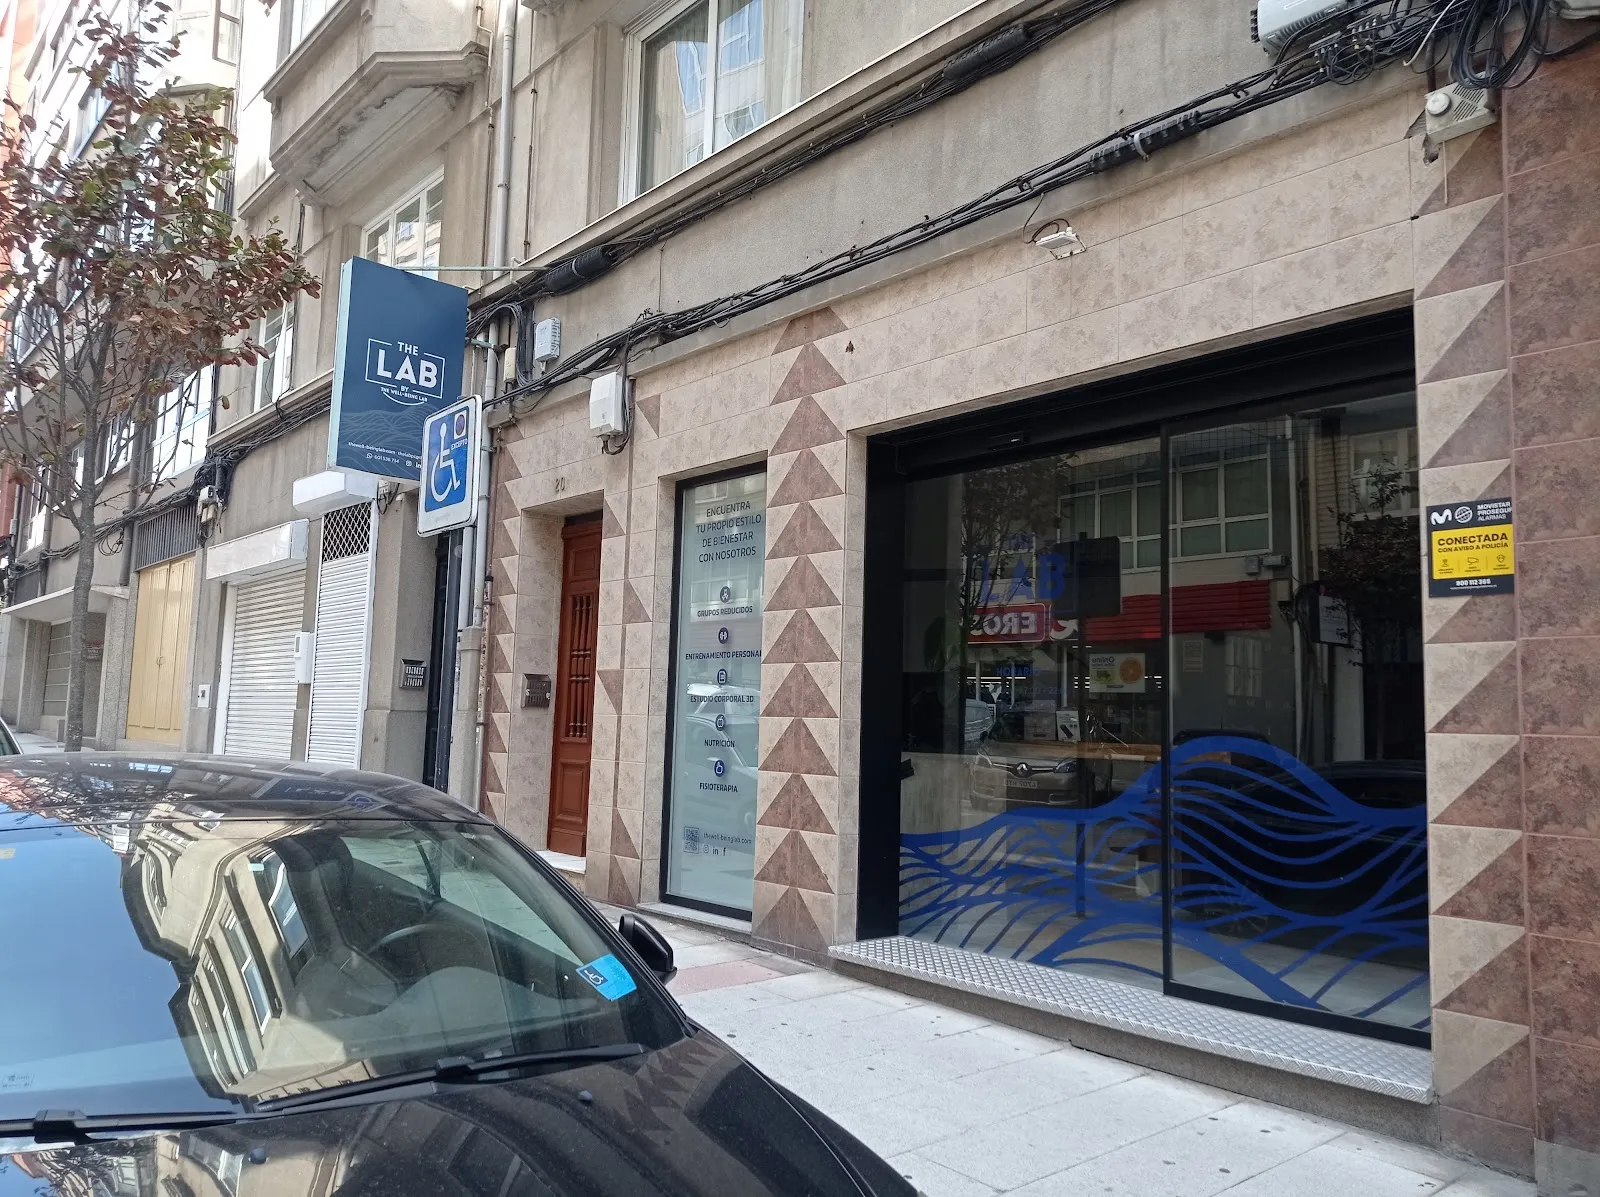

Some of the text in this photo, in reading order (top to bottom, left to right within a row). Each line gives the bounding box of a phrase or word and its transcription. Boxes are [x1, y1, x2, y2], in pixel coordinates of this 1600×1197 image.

[398, 341, 418, 356] THE
[376, 348, 438, 388] LAB
[391, 390, 418, 400] WELL-BEING
[451, 438, 468, 450] EXCEPTO
[555, 477, 566, 492] 20
[706, 501, 751, 517] ENCUENTRA
[1477, 502, 1511, 510] MOVISTAR
[696, 514, 762, 533] TU PROPIO ESTILO
[702, 531, 754, 548] DE BIENESTAR
[1438, 533, 1508, 546] CONECTADA
[698, 546, 756, 562] CON NOSOTROS
[980, 551, 1066, 602] LAB
[697, 605, 753, 617] GRUPOS REDUCIDOS
[685, 651, 731, 660] ENTRENAMIENTO
[690, 695, 754, 703] ESTUDIO CORPORAL 3D
[704, 738, 735, 748] NUTRICIÓN
[700, 782, 738, 792] FISIOTERAPIA
